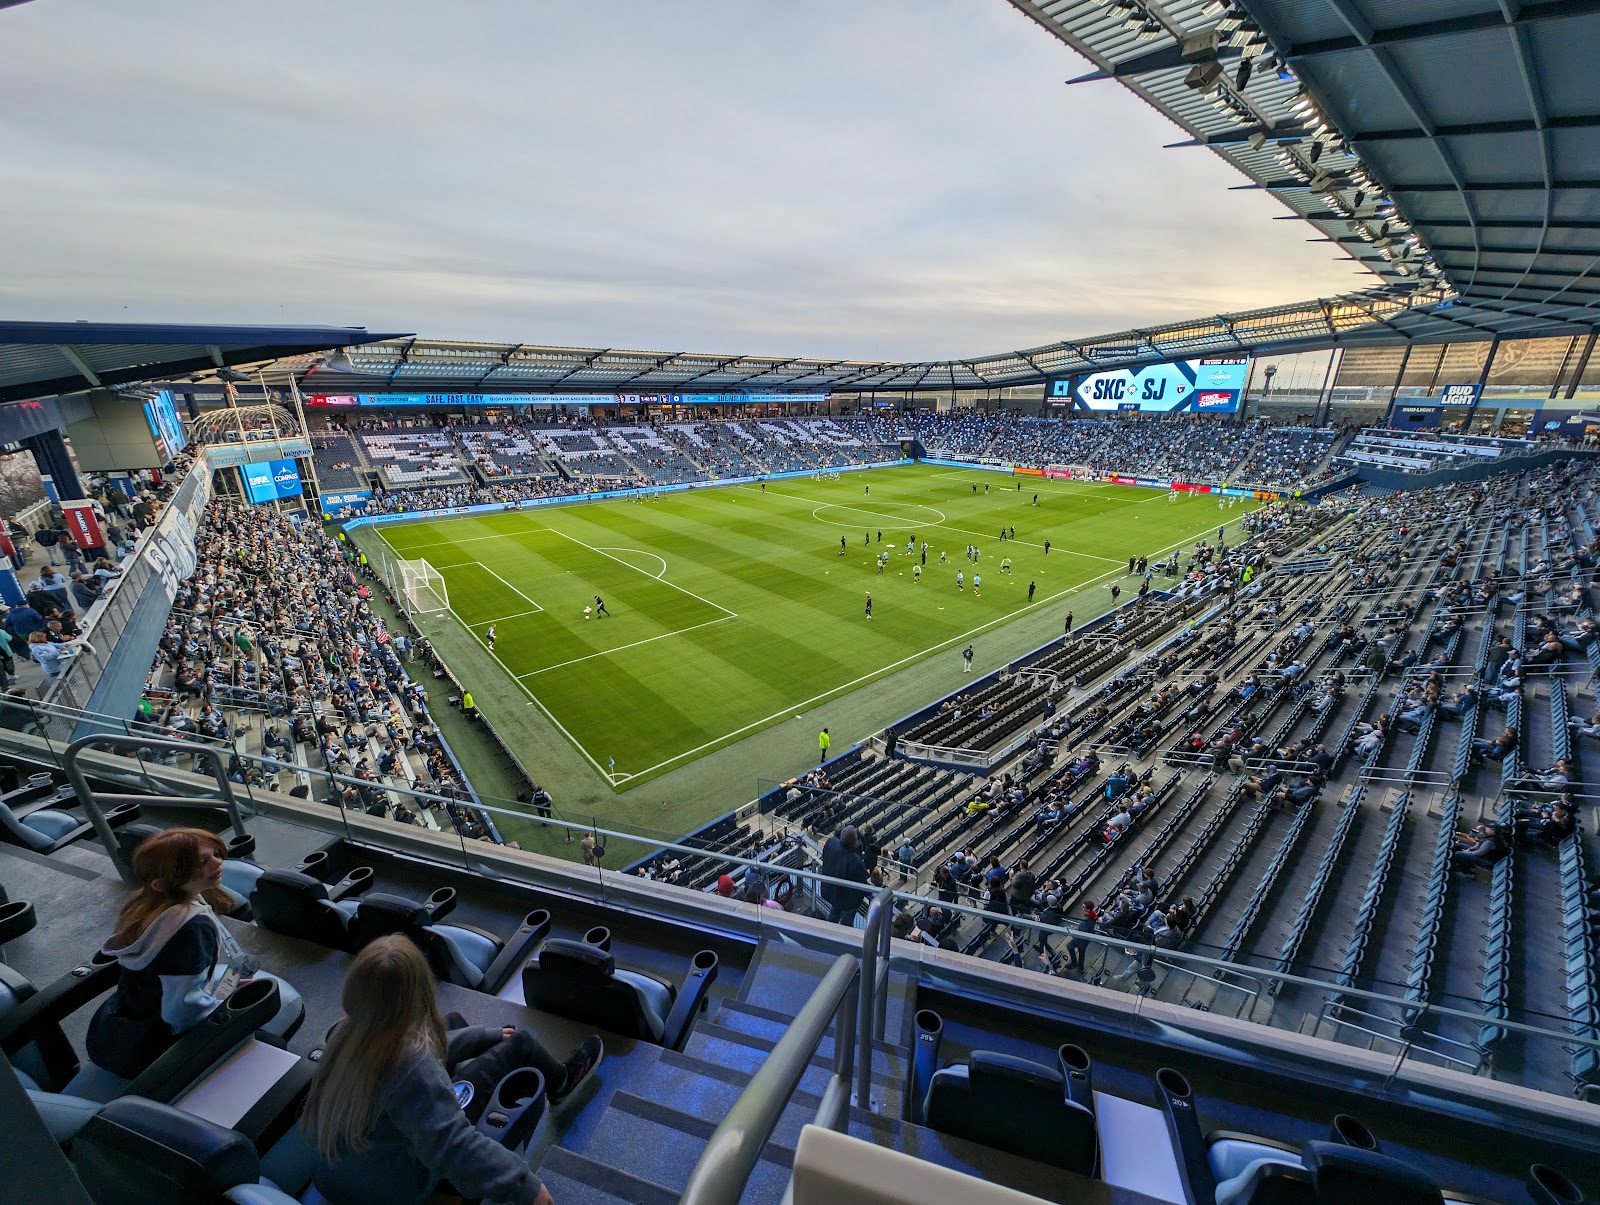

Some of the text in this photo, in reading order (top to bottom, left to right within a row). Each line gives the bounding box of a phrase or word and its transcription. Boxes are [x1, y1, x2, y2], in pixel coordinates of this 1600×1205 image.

[1093, 378, 1126, 400] SKC
[1141, 377, 1167, 400] SJ
[1448, 385, 1474, 395] BUD
[425, 394, 486, 404] SAFE. FAST. EASY.
[1201, 393, 1220, 401] PRICE
[1441, 395, 1475, 405] LIGHT
[1199, 398, 1229, 407] CHOPPER
[274, 473, 298, 483] COMPASS
[74, 510, 88, 531] CHOPPER
[84, 532, 94, 545] PRICE
